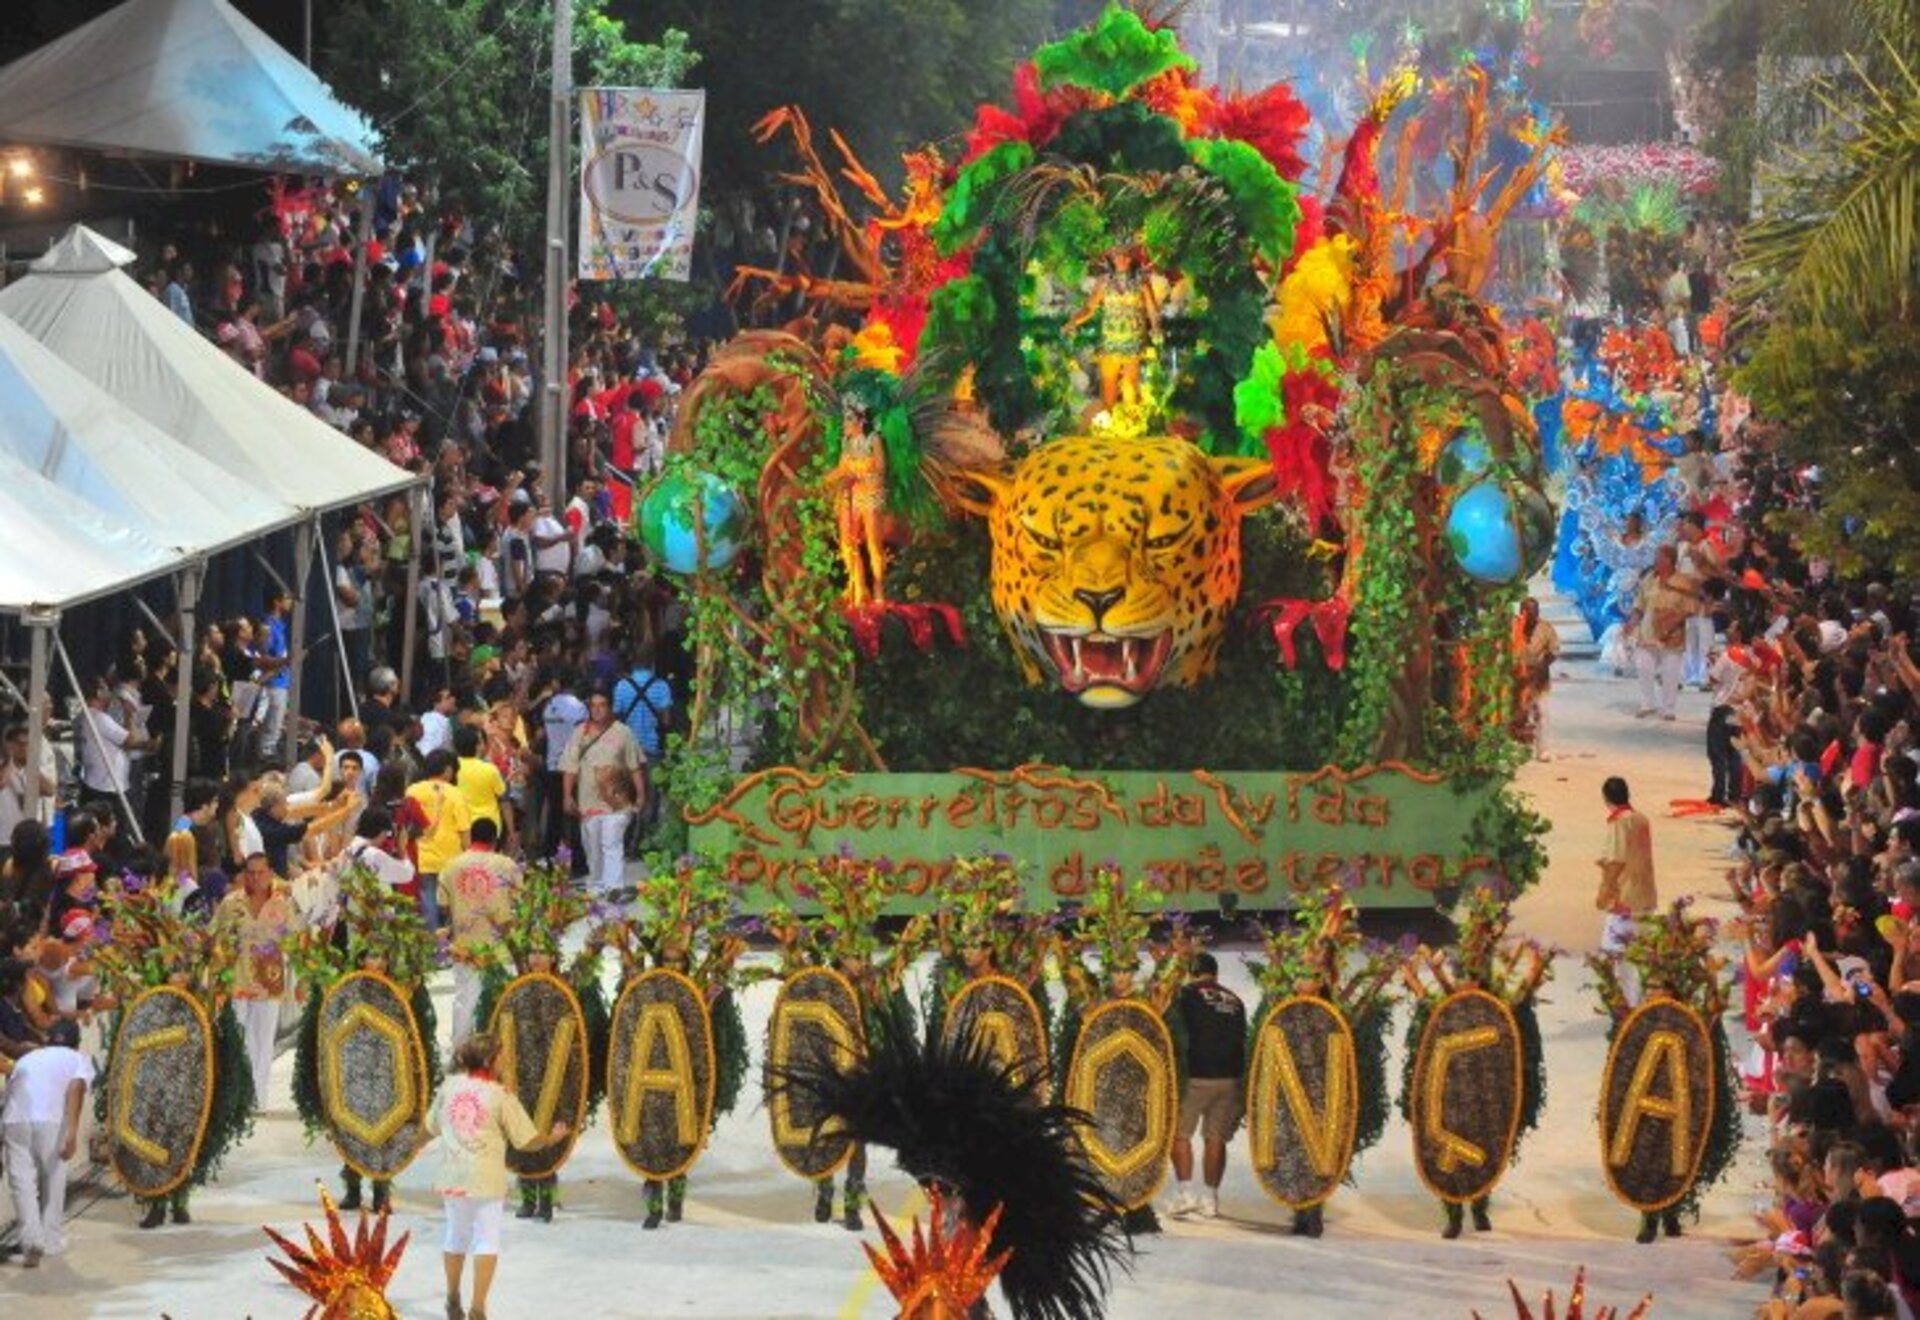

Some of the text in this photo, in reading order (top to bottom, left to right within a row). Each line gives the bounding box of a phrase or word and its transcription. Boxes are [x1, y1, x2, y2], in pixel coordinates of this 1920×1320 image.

[614, 152, 678, 212] P&S
[769, 783, 1100, 847] Guerreiros
[1135, 779, 1206, 828] da
